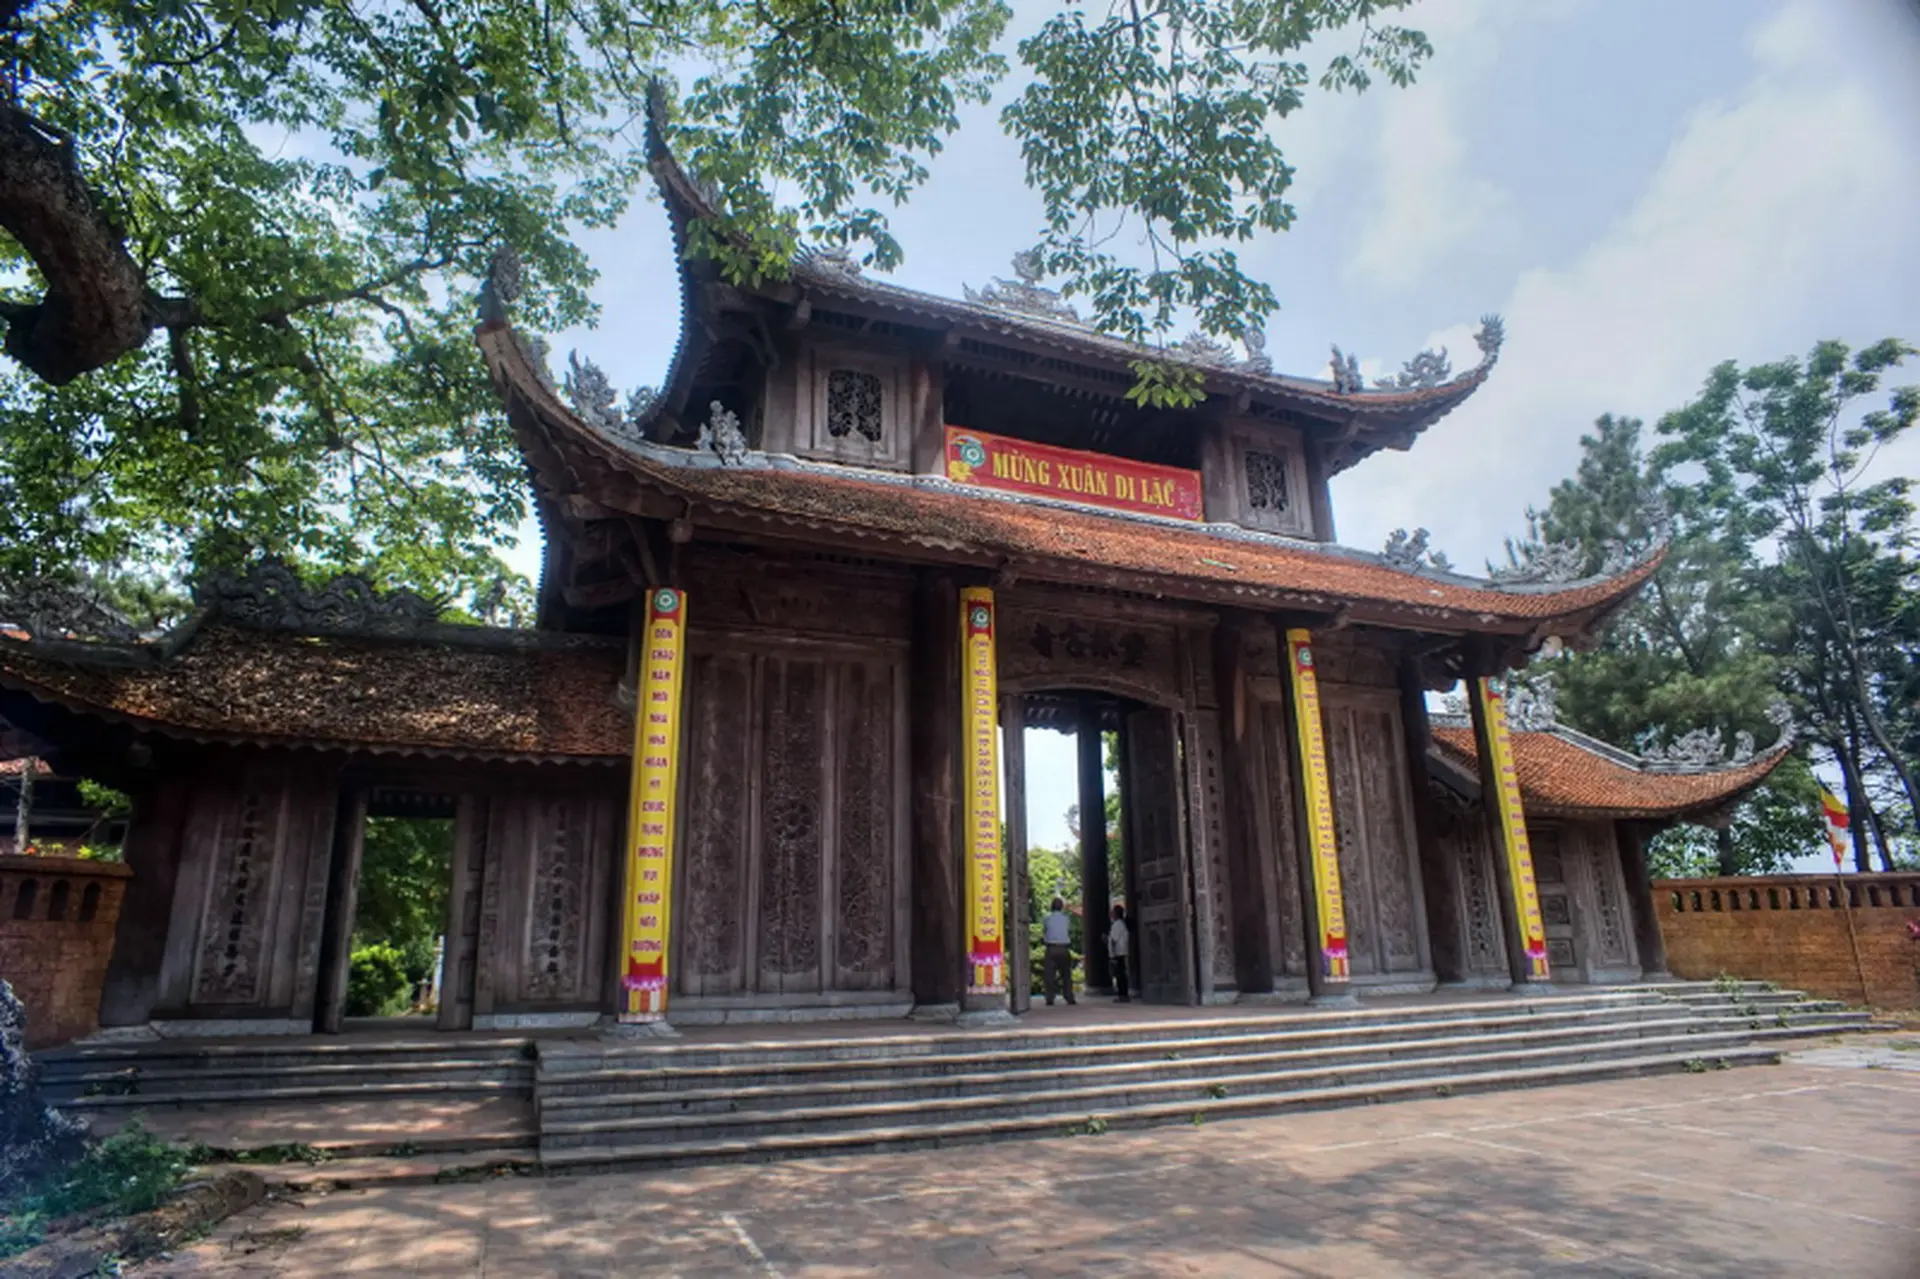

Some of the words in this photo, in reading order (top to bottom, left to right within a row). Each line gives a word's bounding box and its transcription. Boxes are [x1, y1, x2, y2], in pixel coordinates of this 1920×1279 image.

[992, 450, 1050, 486] MỪNG
[1057, 462, 1108, 496] XUÂN
[1115, 474, 1136, 500] DI
[1141, 476, 1176, 509] LẶC
